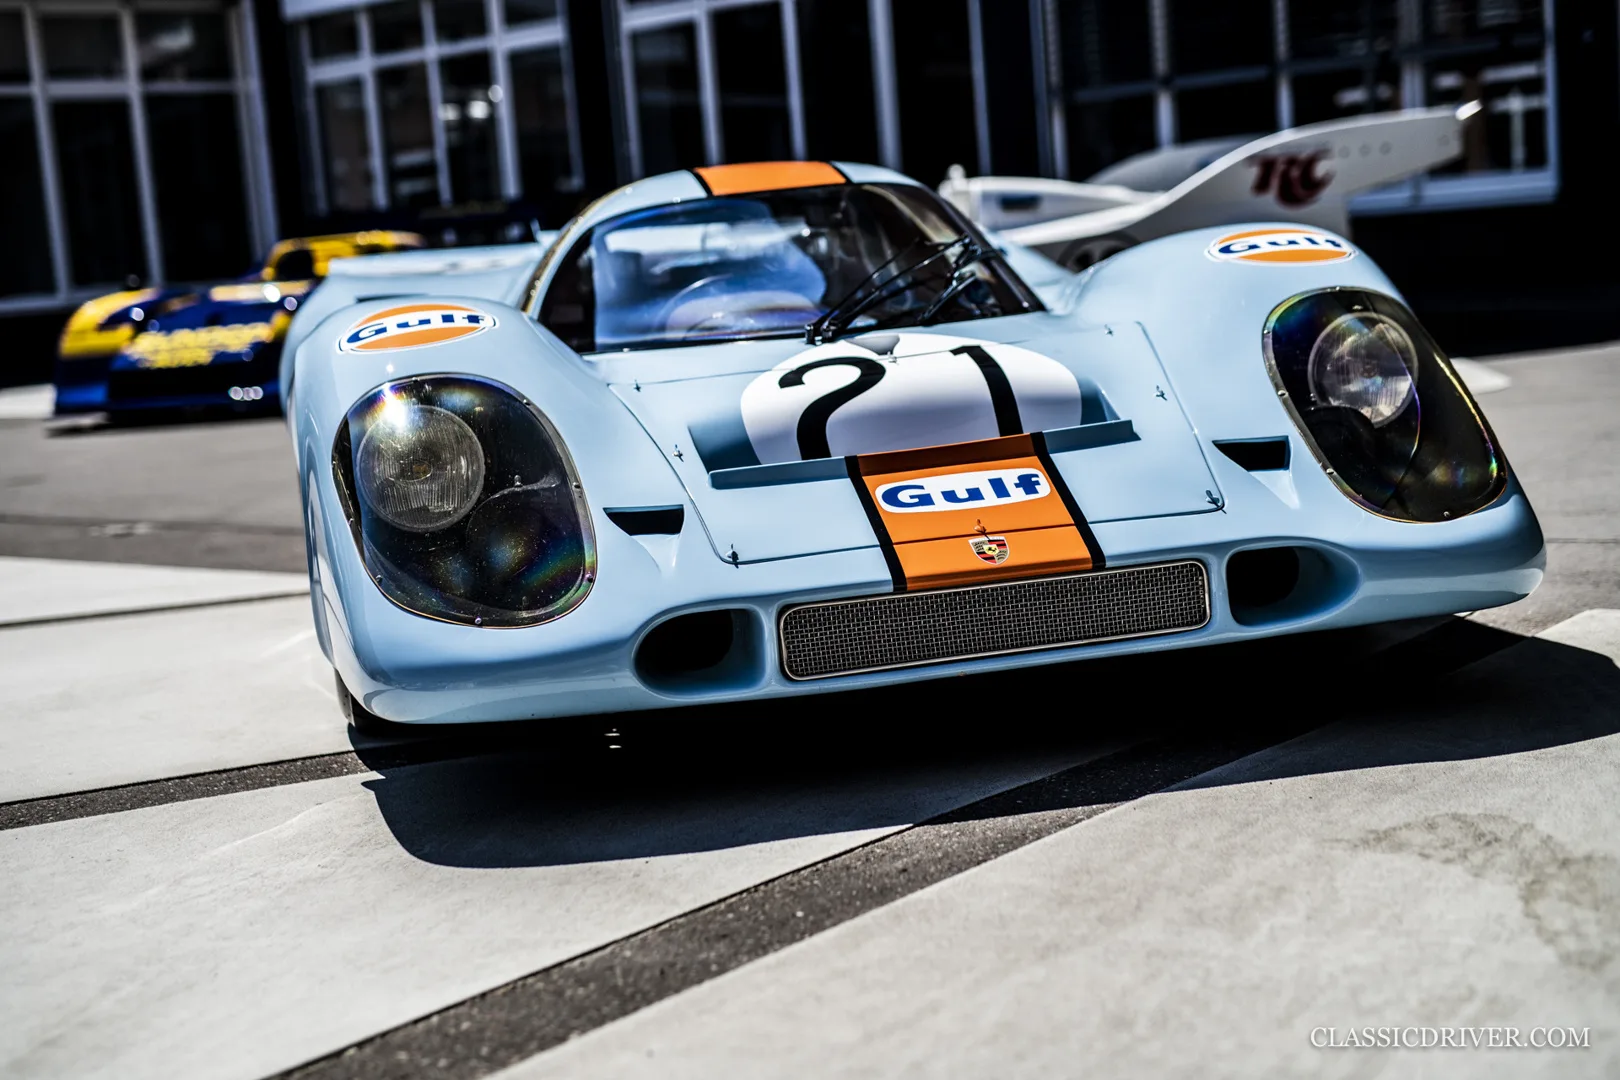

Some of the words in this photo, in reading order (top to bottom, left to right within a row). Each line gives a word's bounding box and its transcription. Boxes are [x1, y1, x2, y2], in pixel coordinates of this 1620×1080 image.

[1218, 236, 1344, 254] Gulf
[346, 313, 485, 344] Gulf
[778, 344, 1024, 460] 21
[881, 472, 1042, 508] Gulf
